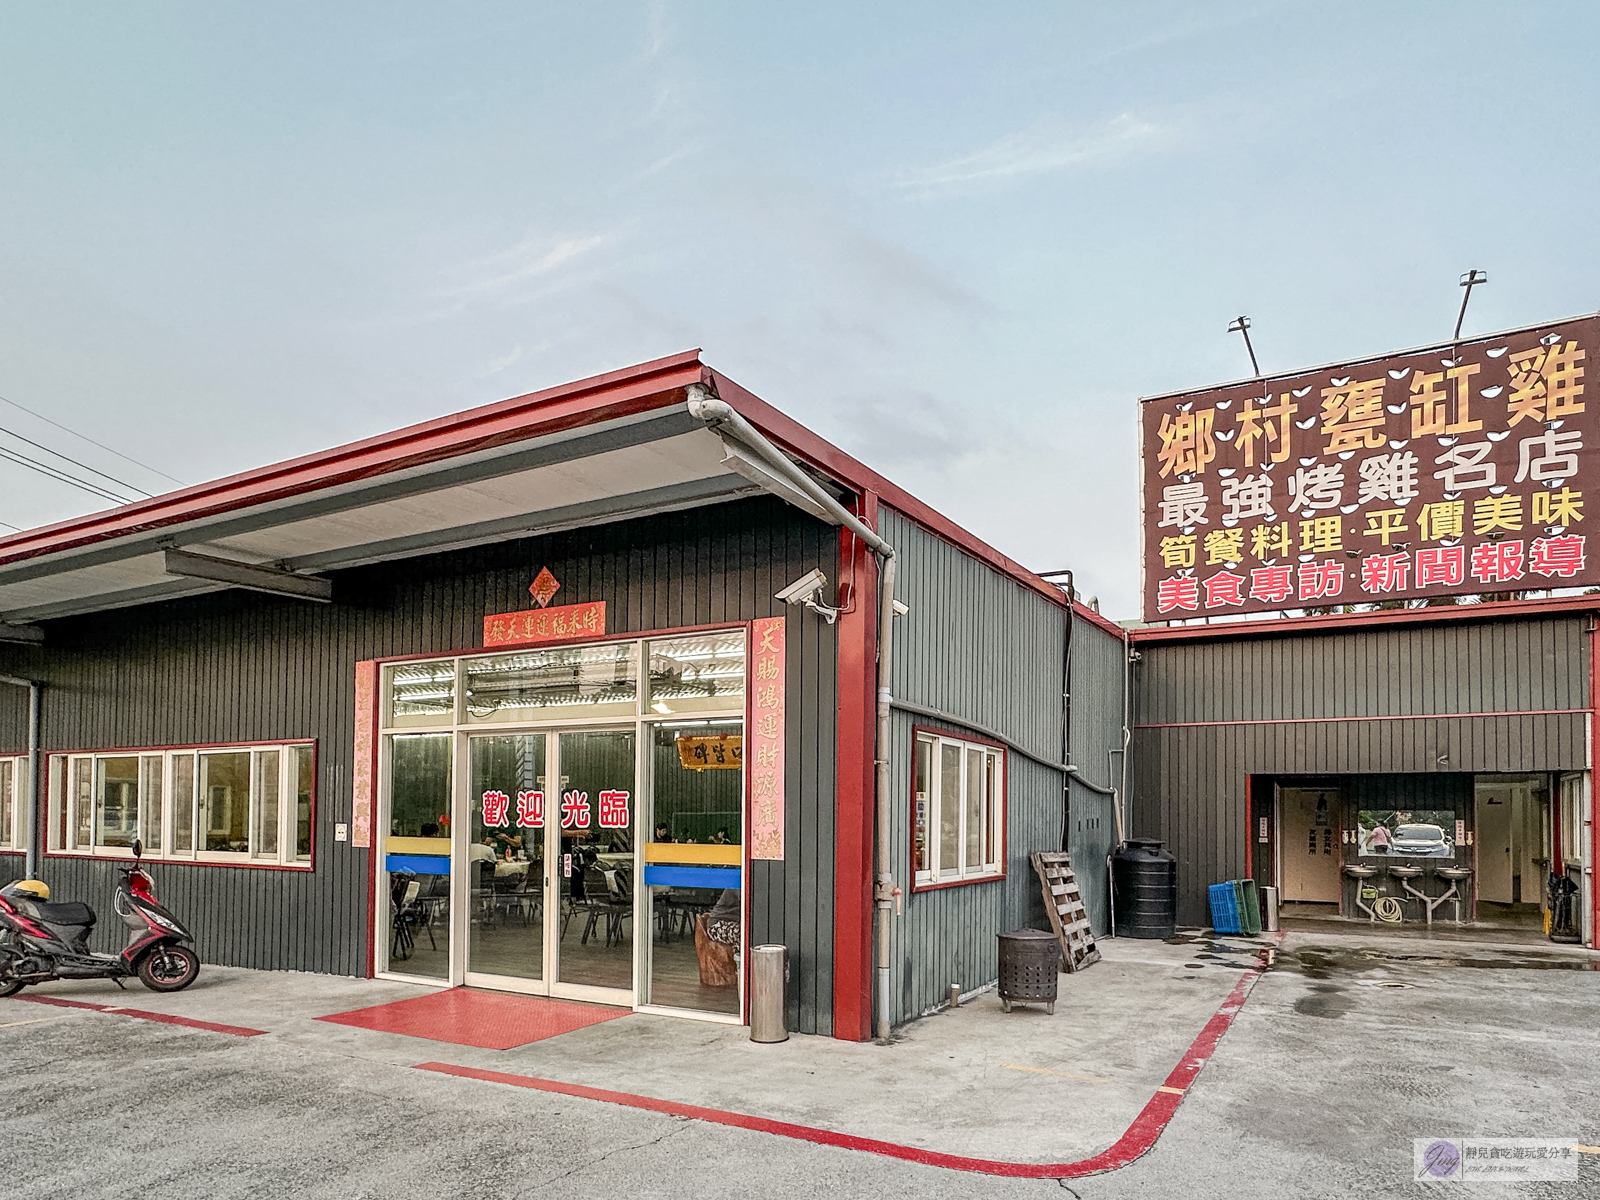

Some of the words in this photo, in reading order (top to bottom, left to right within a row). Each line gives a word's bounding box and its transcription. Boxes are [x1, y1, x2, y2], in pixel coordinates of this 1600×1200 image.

[1157, 339, 1586, 478] 鄉村甕缸雞
[1158, 430, 1584, 529] 最強烤雞名店
[756, 626, 780, 829] 天賜鴻運財源廣
[482, 789, 629, 829] 歡迎光臨
